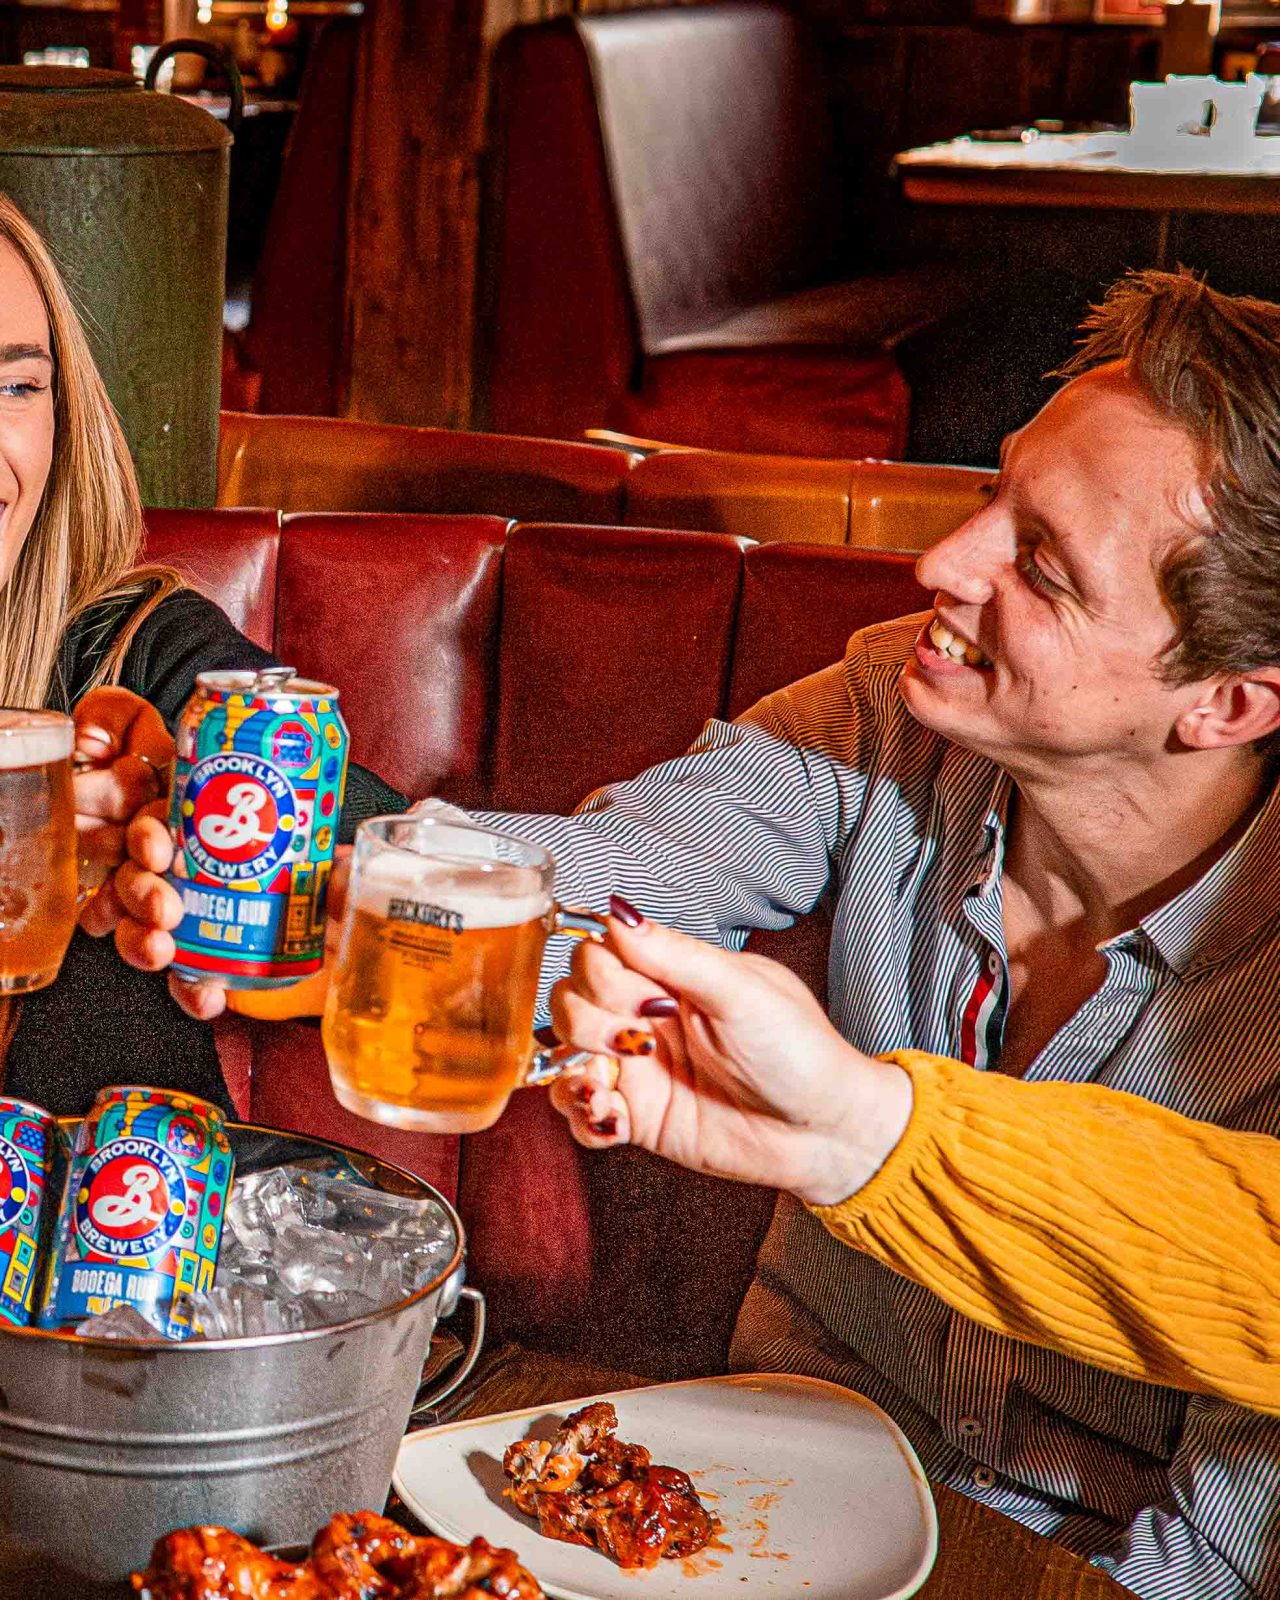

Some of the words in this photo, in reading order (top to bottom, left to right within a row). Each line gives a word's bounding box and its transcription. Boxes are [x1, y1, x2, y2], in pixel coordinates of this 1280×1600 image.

[193, 756, 288, 799] BROOKLYN
[187, 835, 278, 879] BREWERY
[237, 898, 271, 927] RUN
[89, 1141, 182, 1182] BROOKLYN
[79, 1221, 169, 1255] BREWERY
[71, 1269, 122, 1297] BODEGA
